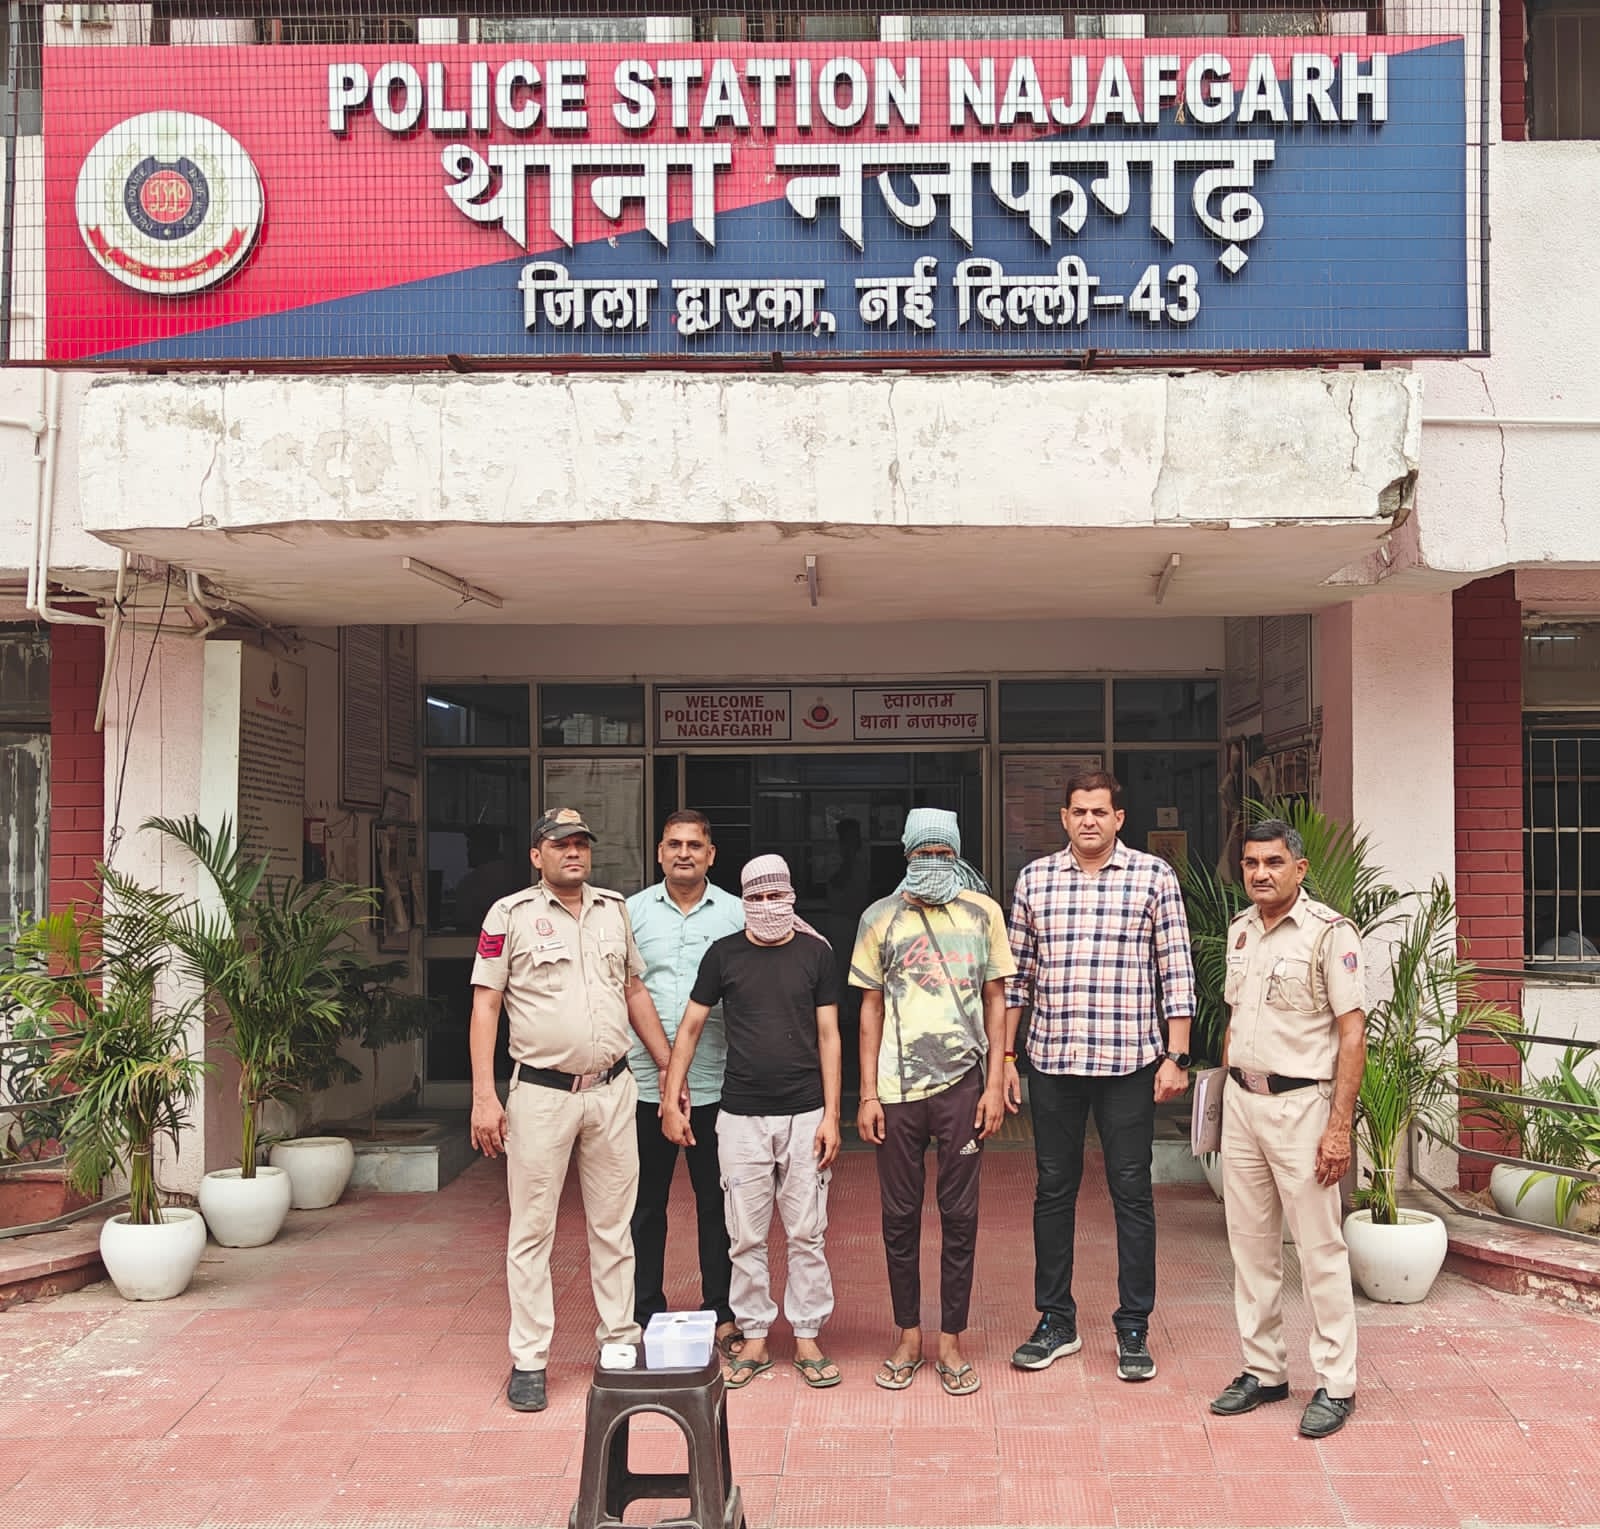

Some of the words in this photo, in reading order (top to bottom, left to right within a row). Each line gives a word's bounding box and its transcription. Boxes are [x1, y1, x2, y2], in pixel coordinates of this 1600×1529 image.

[328, 60, 589, 134] POLICE
[612, 57, 921, 130] STATION
[948, 52, 1389, 128] NAJAFGARH
[441, 143, 733, 252] थाना
[774, 139, 1276, 275] नजफगढ़
[518, 261, 658, 331] जिला
[671, 278, 837, 336] द्वारका,
[854, 255, 938, 331] नई
[686, 695, 765, 708] WELCOME
[882, 692, 956, 709] स्वागतम
[664, 710, 719, 723] POLICE
[723, 709, 786, 722] STATION
[860, 714, 901, 730] थाना
[906, 713, 979, 733] नजफगढ़
[677, 723, 773, 737] NAGAFGARH
